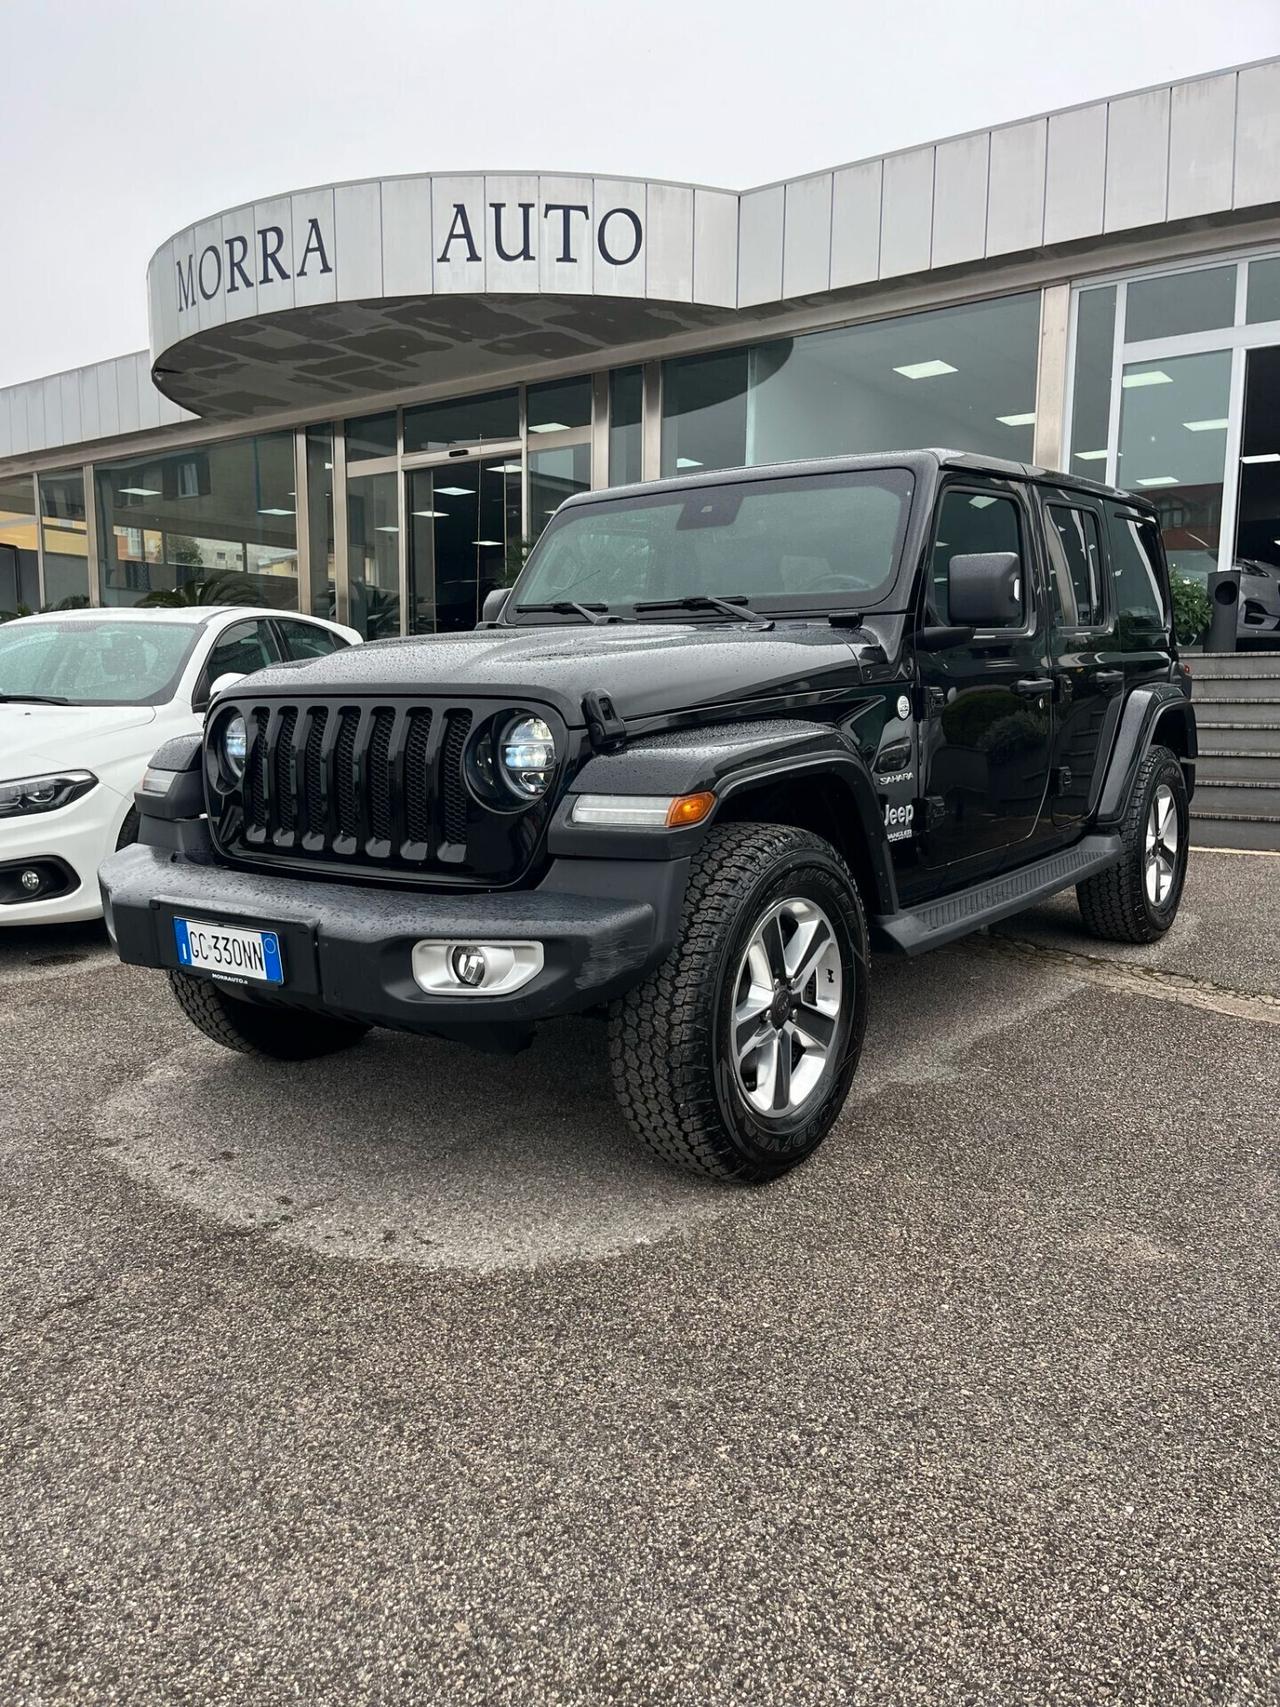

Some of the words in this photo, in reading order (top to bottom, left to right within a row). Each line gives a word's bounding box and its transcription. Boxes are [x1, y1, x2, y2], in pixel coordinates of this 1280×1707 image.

[176, 218, 333, 311] MORRA
[437, 203, 643, 266] AUTO
[879, 772, 914, 785] SAHARA
[884, 804, 914, 826] Jeep
